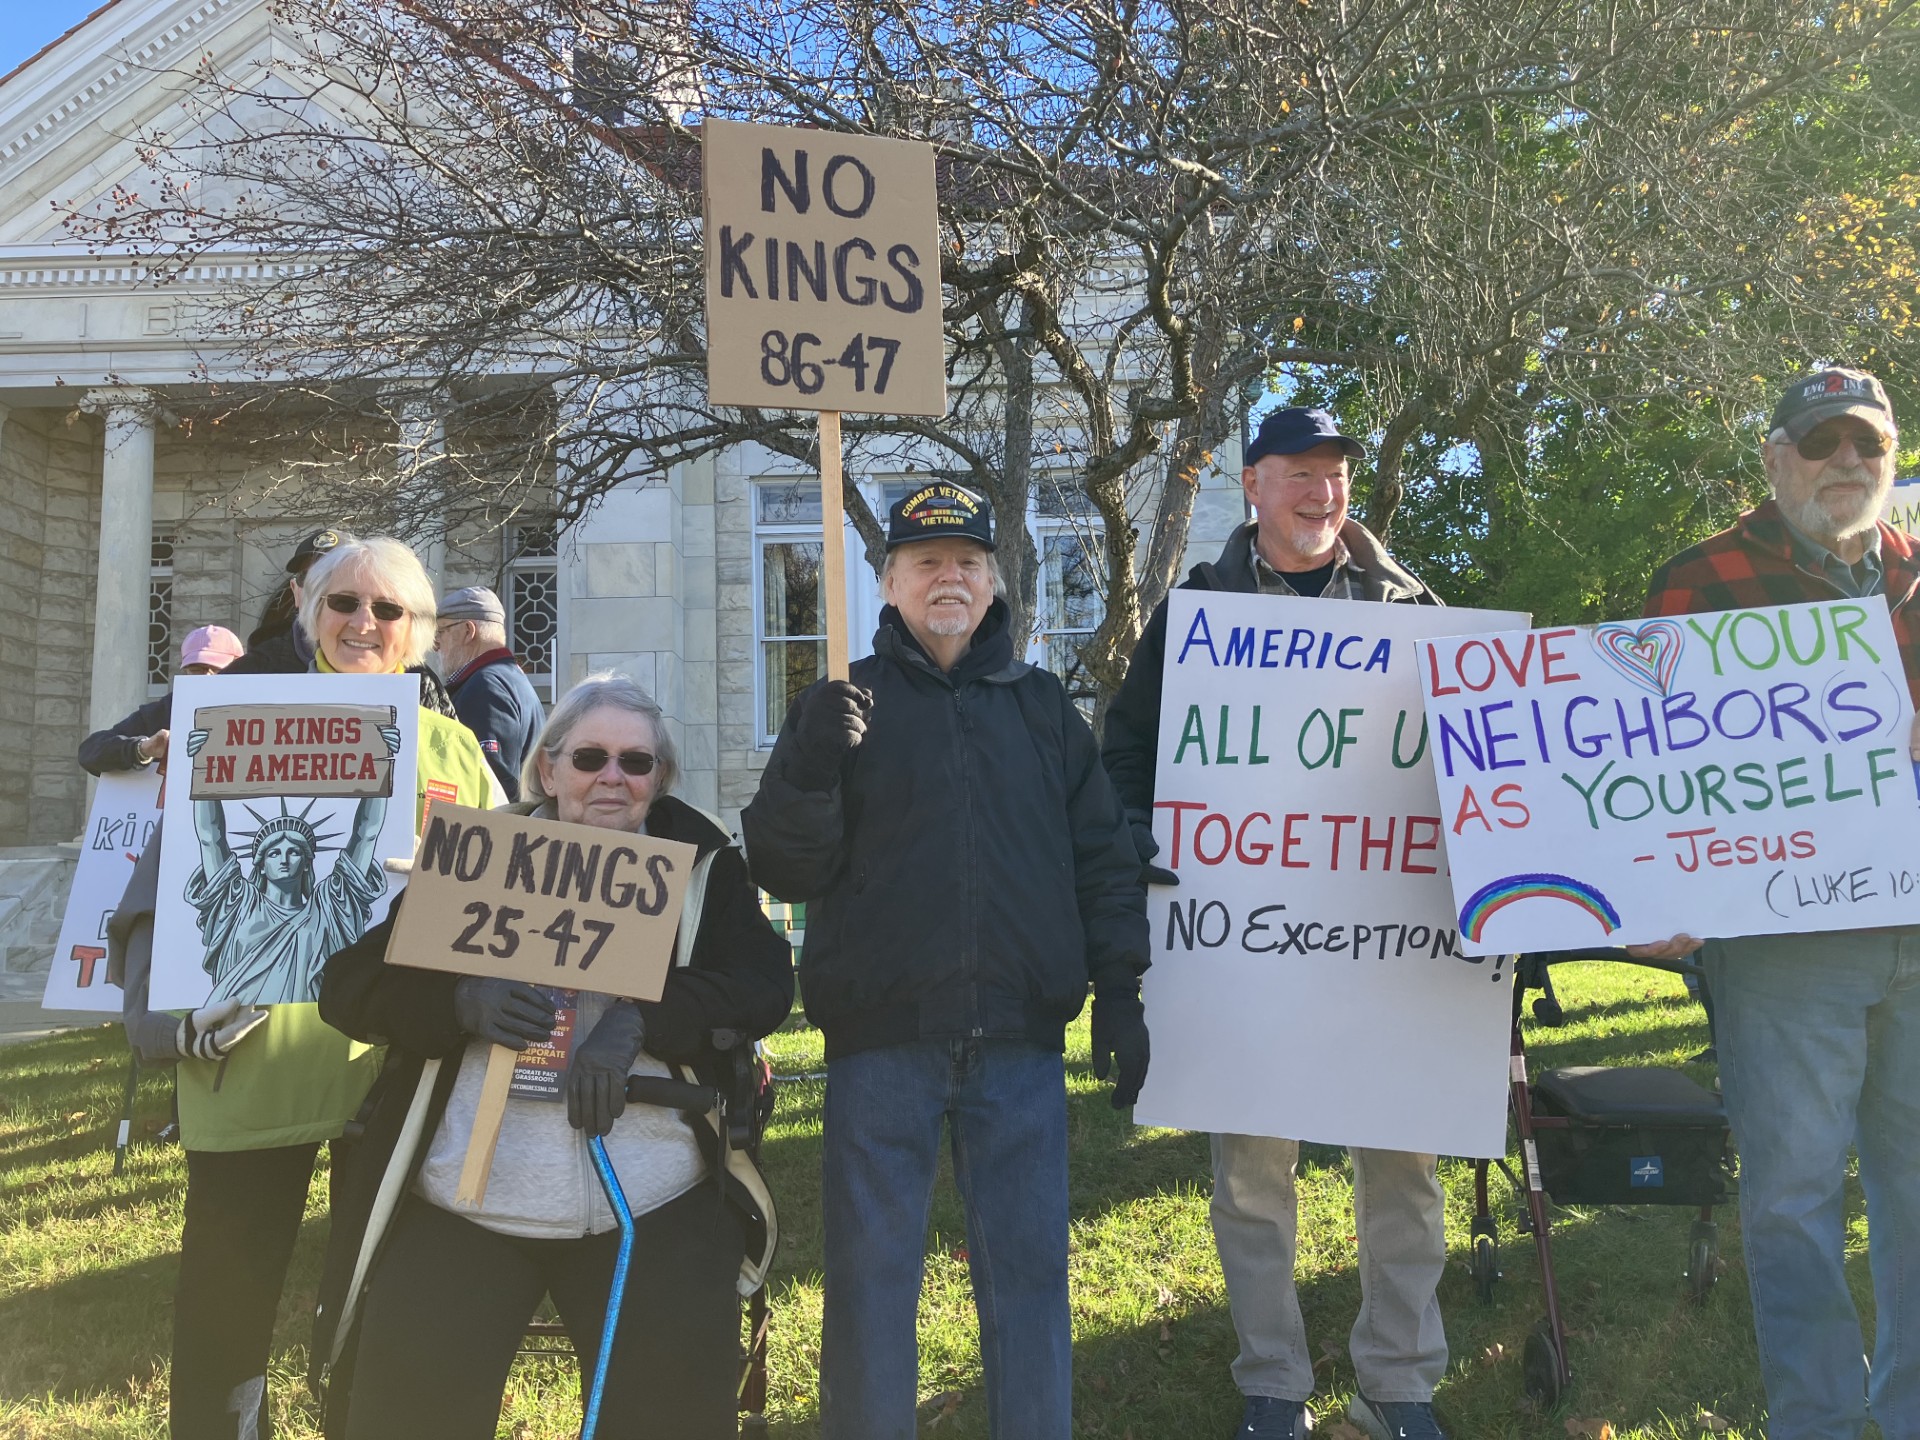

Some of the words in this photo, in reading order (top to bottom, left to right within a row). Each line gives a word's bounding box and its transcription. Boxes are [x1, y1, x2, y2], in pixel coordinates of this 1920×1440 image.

[761, 147, 876, 219] NO
[719, 225, 924, 313] KINGS
[761, 330, 901, 394] 86-47
[902, 487, 935, 517] COMBAT
[939, 486, 979, 515] VETERAN
[921, 516, 964, 526] VIETNAM
[1178, 608, 1391, 673] AMERICA
[1427, 629, 1580, 697] LOVE
[1686, 605, 1881, 676] YOUR
[225, 718, 265, 746] NO
[274, 717, 361, 745] KINGS
[1173, 704, 1269, 766] ALL
[1297, 708, 1364, 770] OF
[1392, 710, 1428, 769] U
[205, 755, 236, 783] IN
[245, 753, 377, 782] AMERICA
[1453, 783, 1530, 835] AS
[1562, 748, 1897, 830] YOURSELF
[421, 816, 493, 882] NO
[504, 831, 674, 916] KINGS
[1153, 801, 1451, 877] TOGETHE
[1666, 827, 1817, 873] Jesus
[1766, 866, 1878, 918] (LUKE
[450, 901, 615, 971] 25-47
[1166, 899, 1230, 951] NO
[515, 1074, 554, 1083] GRASSROOTS
[519, 1047, 565, 1058] RPORATE
